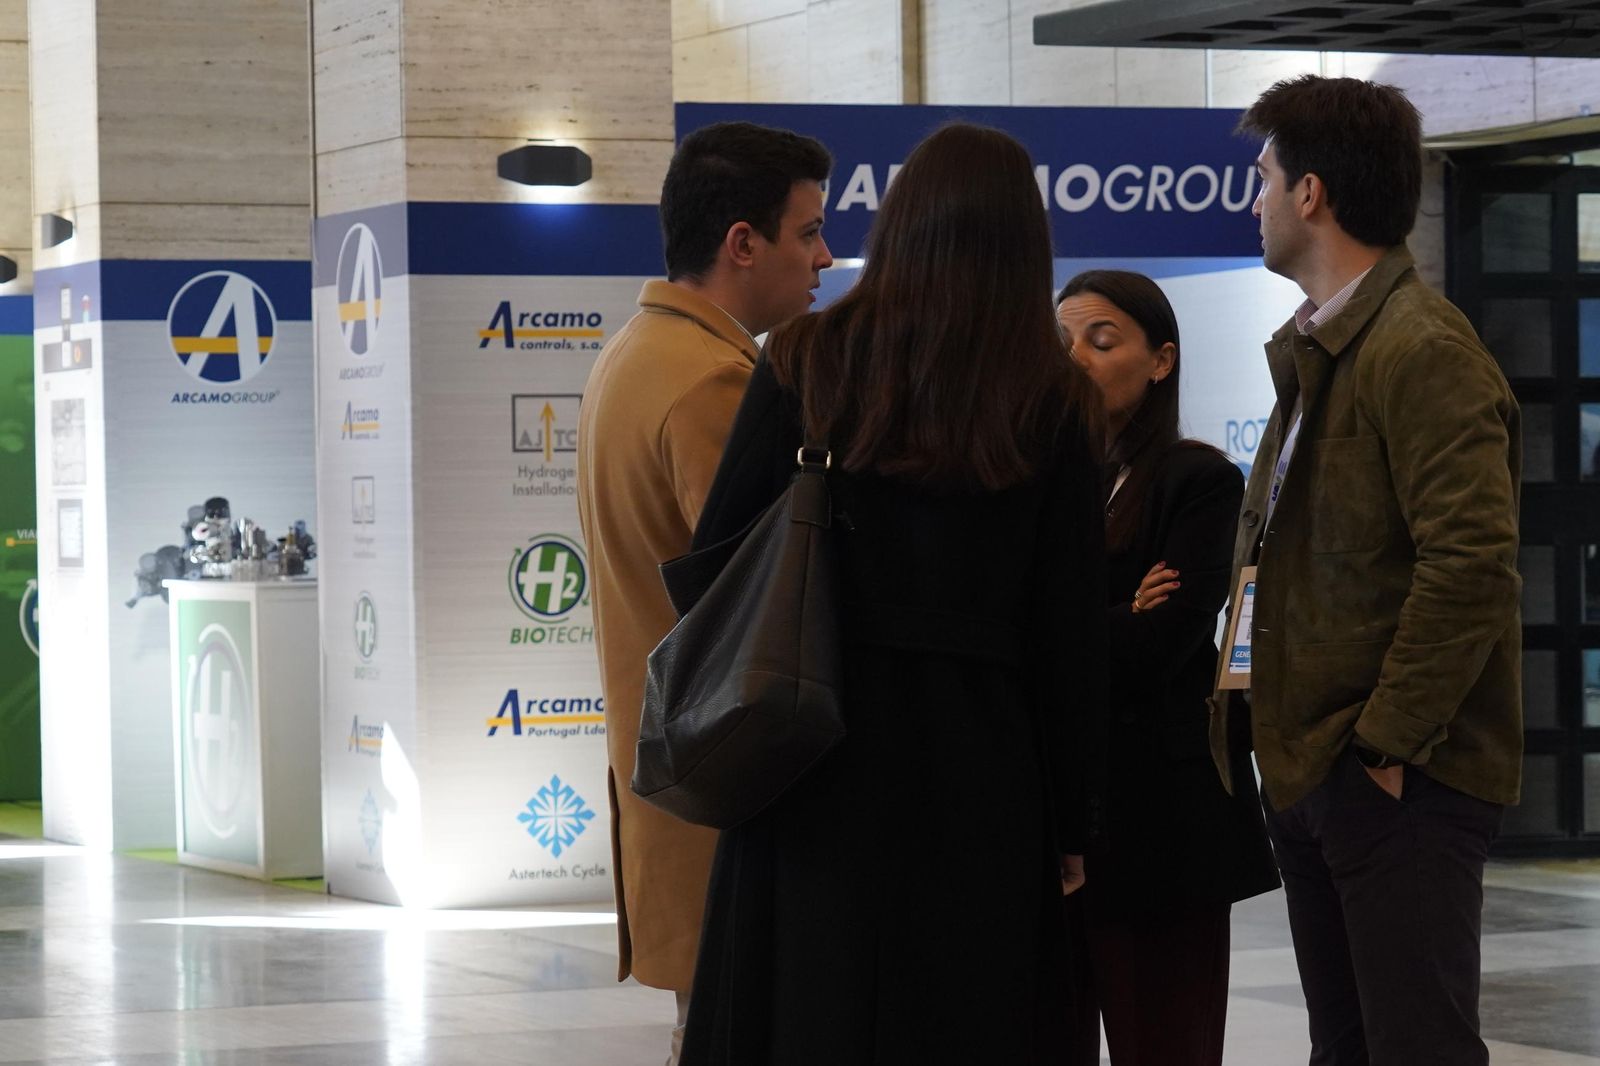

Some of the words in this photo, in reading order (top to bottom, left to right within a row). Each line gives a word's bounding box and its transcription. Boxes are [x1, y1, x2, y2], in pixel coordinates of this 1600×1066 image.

[479, 301, 602, 349] Arcamo
[520, 339, 576, 350] controls,
[518, 464, 577, 481] Hydroge
[512, 482, 577, 496] Installatio
[16, 528, 38, 540] VIA
[510, 627, 593, 644] BIOTECH
[528, 726, 580, 738] Portugal
[508, 865, 568, 880] Astertech
[571, 864, 606, 880] Cycle
